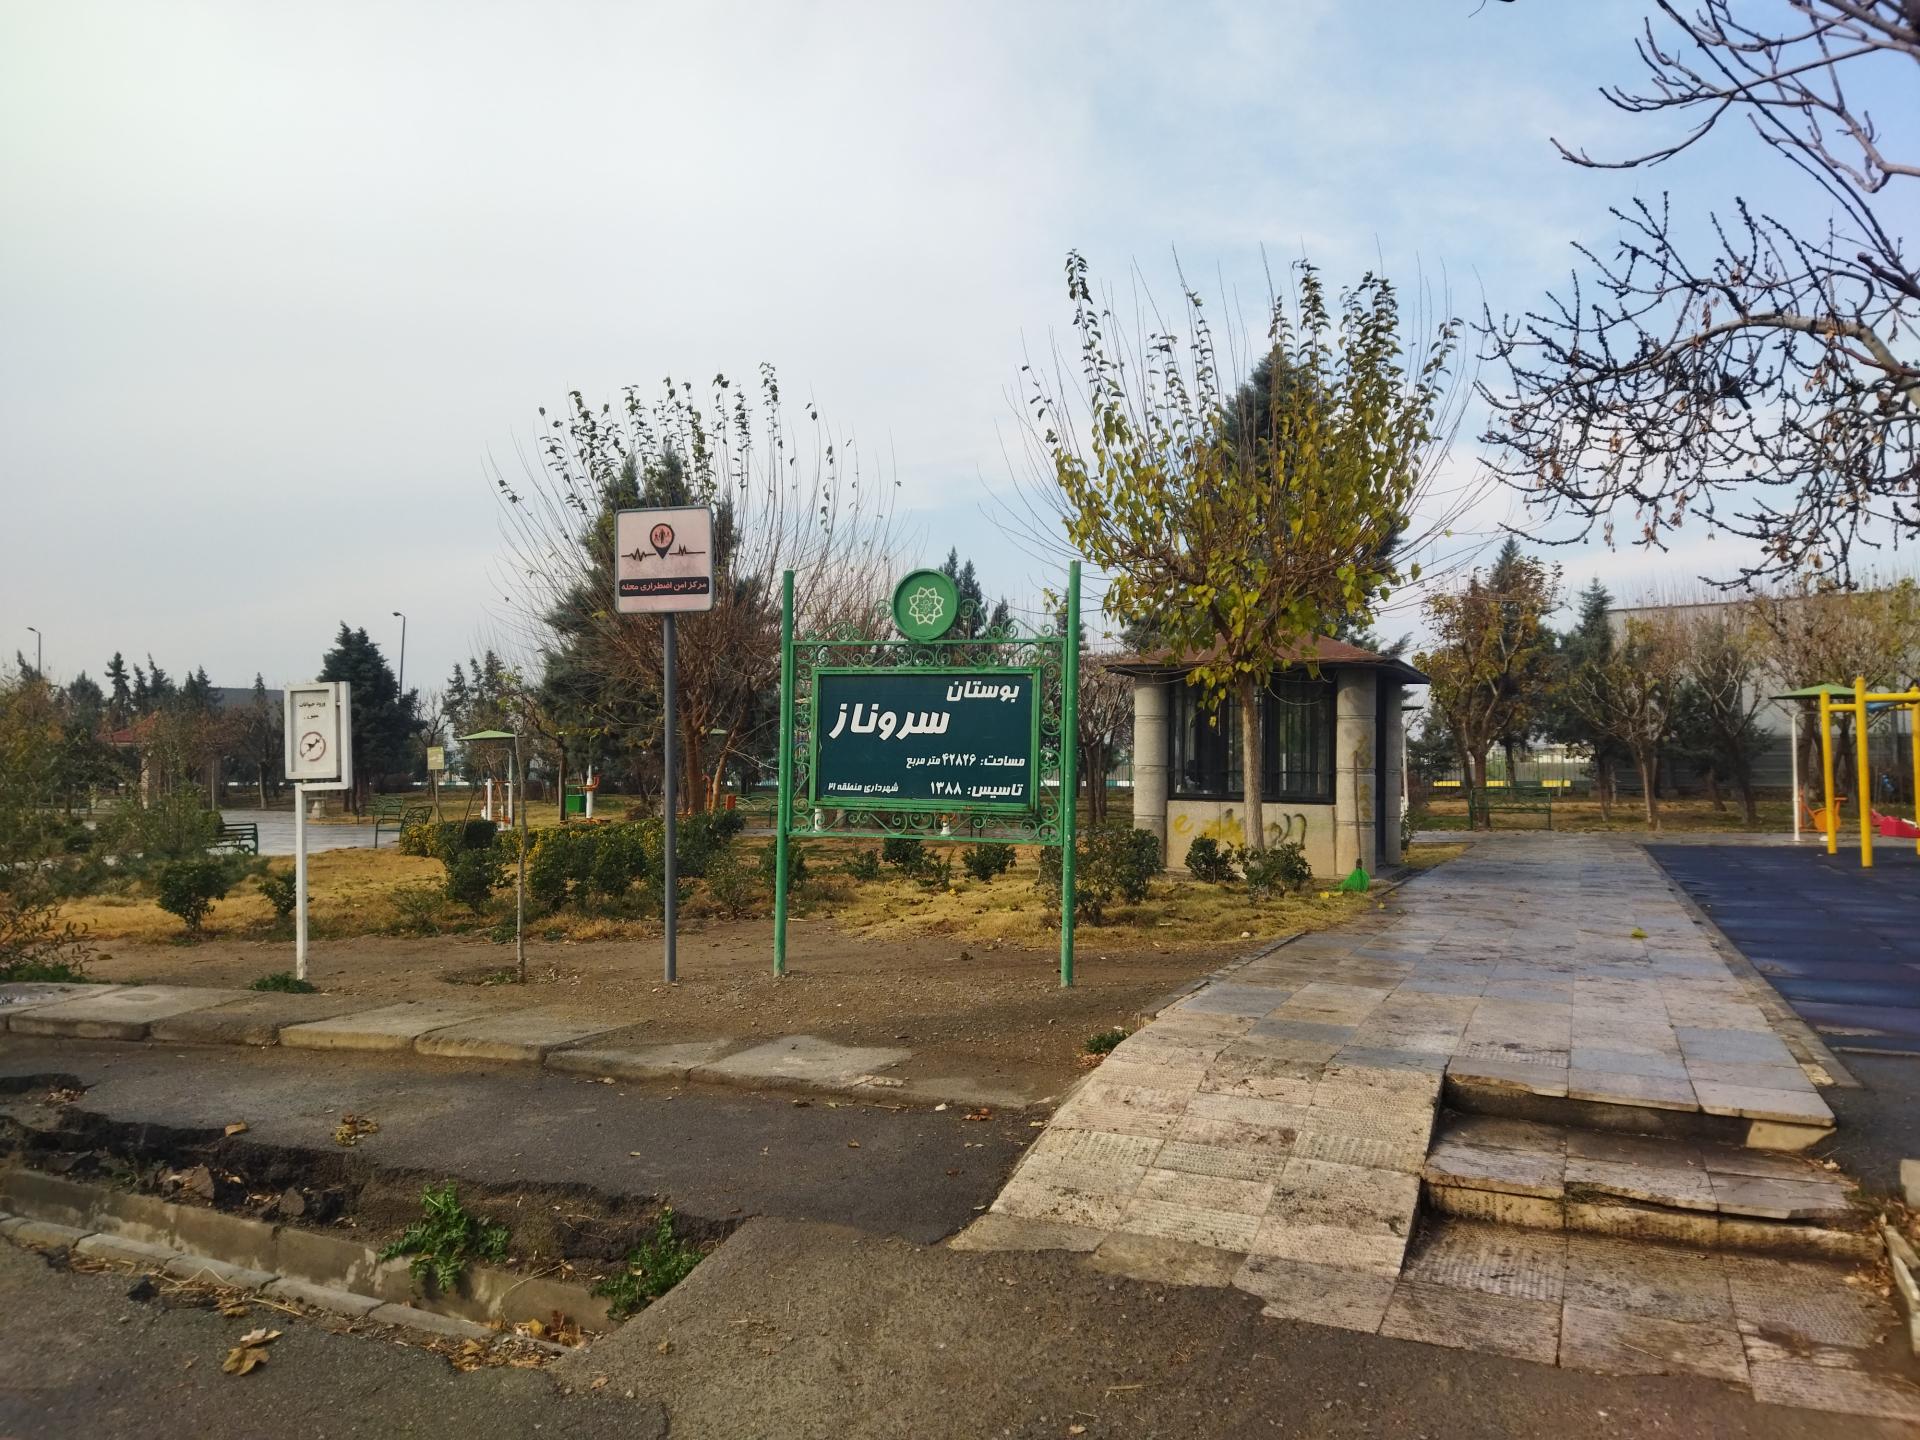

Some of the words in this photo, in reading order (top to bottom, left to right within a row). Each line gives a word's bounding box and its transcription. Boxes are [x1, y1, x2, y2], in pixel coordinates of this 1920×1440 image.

[640, 582, 673, 592] اضطراری
[673, 581, 687, 591] امن
[687, 580, 707, 590] مرکز
[946, 680, 1020, 703] بوستان
[828, 703, 951, 741] سروناز
[905, 756, 926, 769] مربع
[926, 756, 941, 767] متر
[941, 752, 977, 767] ۴۲۸۲۶
[979, 754, 1026, 767] مساحت:
[836, 782, 863, 791] منطقه
[863, 781, 899, 794] شهرداری
[930, 781, 962, 795] ۱۳۸۸
[966, 783, 1024, 799] تاسیس:
